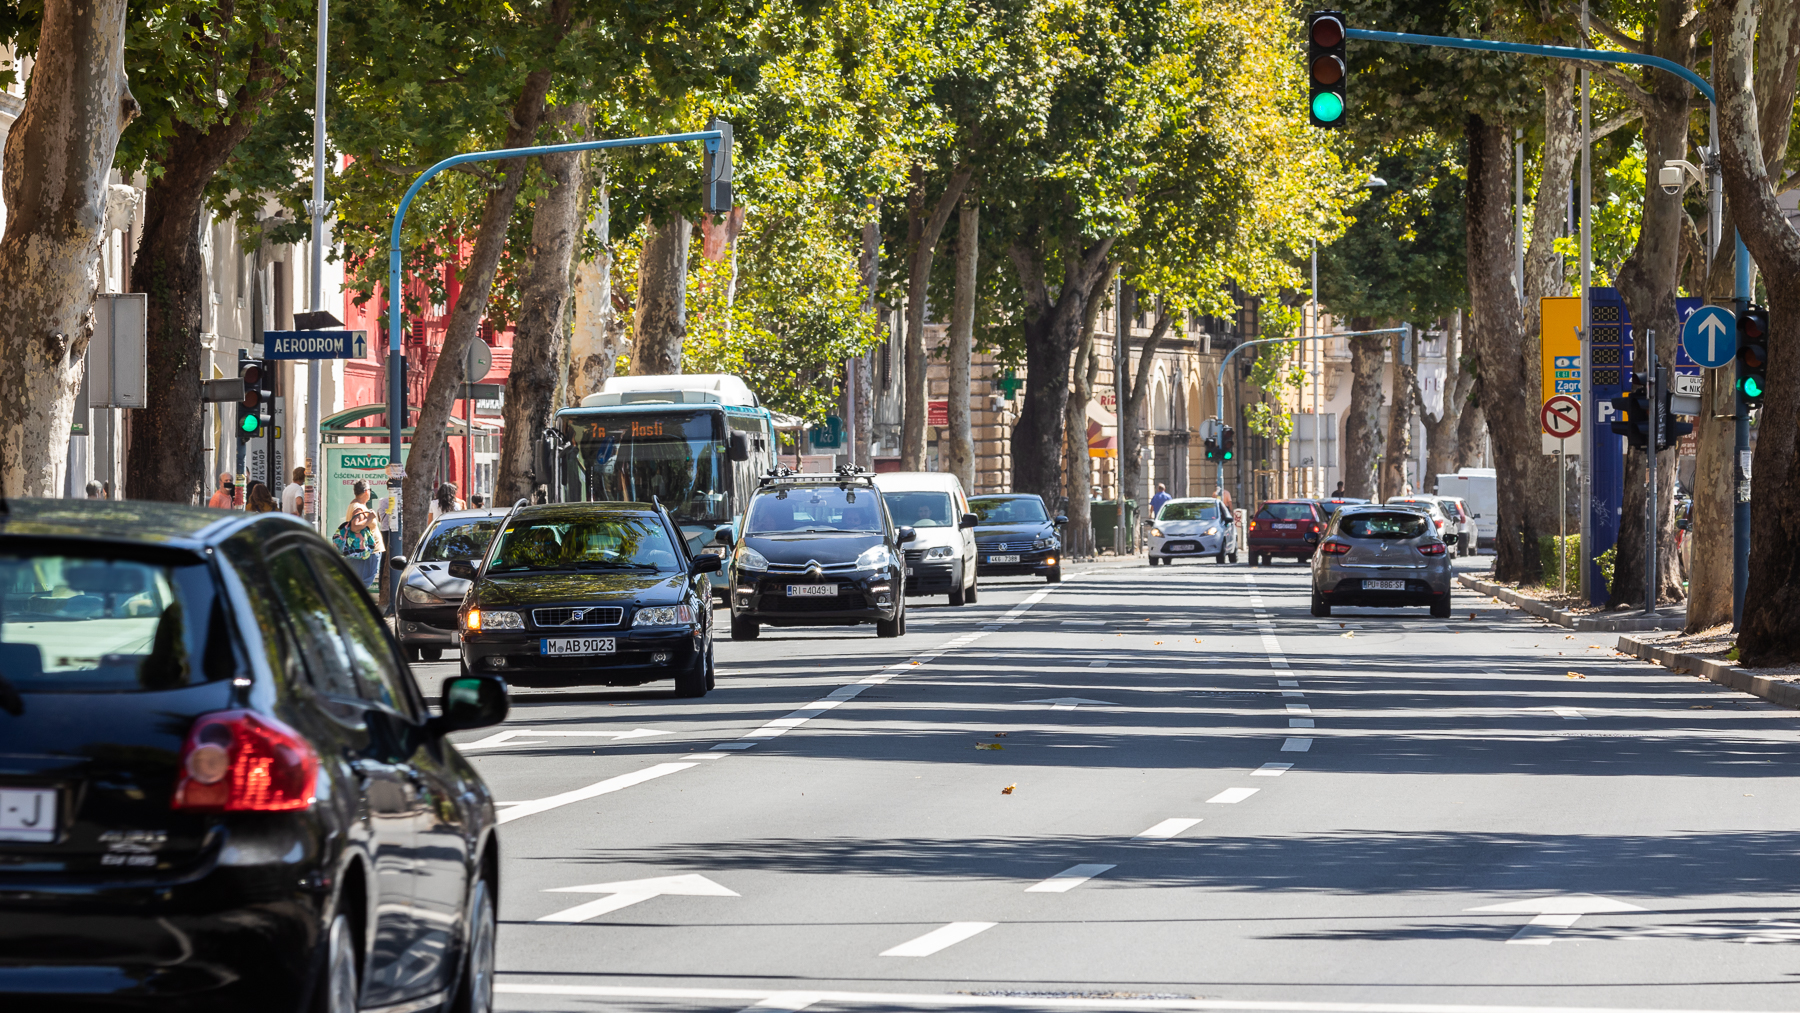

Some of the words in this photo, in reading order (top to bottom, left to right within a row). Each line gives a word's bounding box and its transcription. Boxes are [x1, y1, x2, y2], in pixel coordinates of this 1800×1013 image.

[274, 338, 344, 352] AERODROM
[1598, 401, 1616, 422] P
[631, 421, 663, 437] Hosti
[258, 449, 266, 484] OKSHOP
[343, 456, 389, 467] SANYTO
[792, 586, 801, 595] RI
[548, 640, 557, 653] M
[564, 640, 581, 653] AB
[583, 639, 614, 652] 9023
